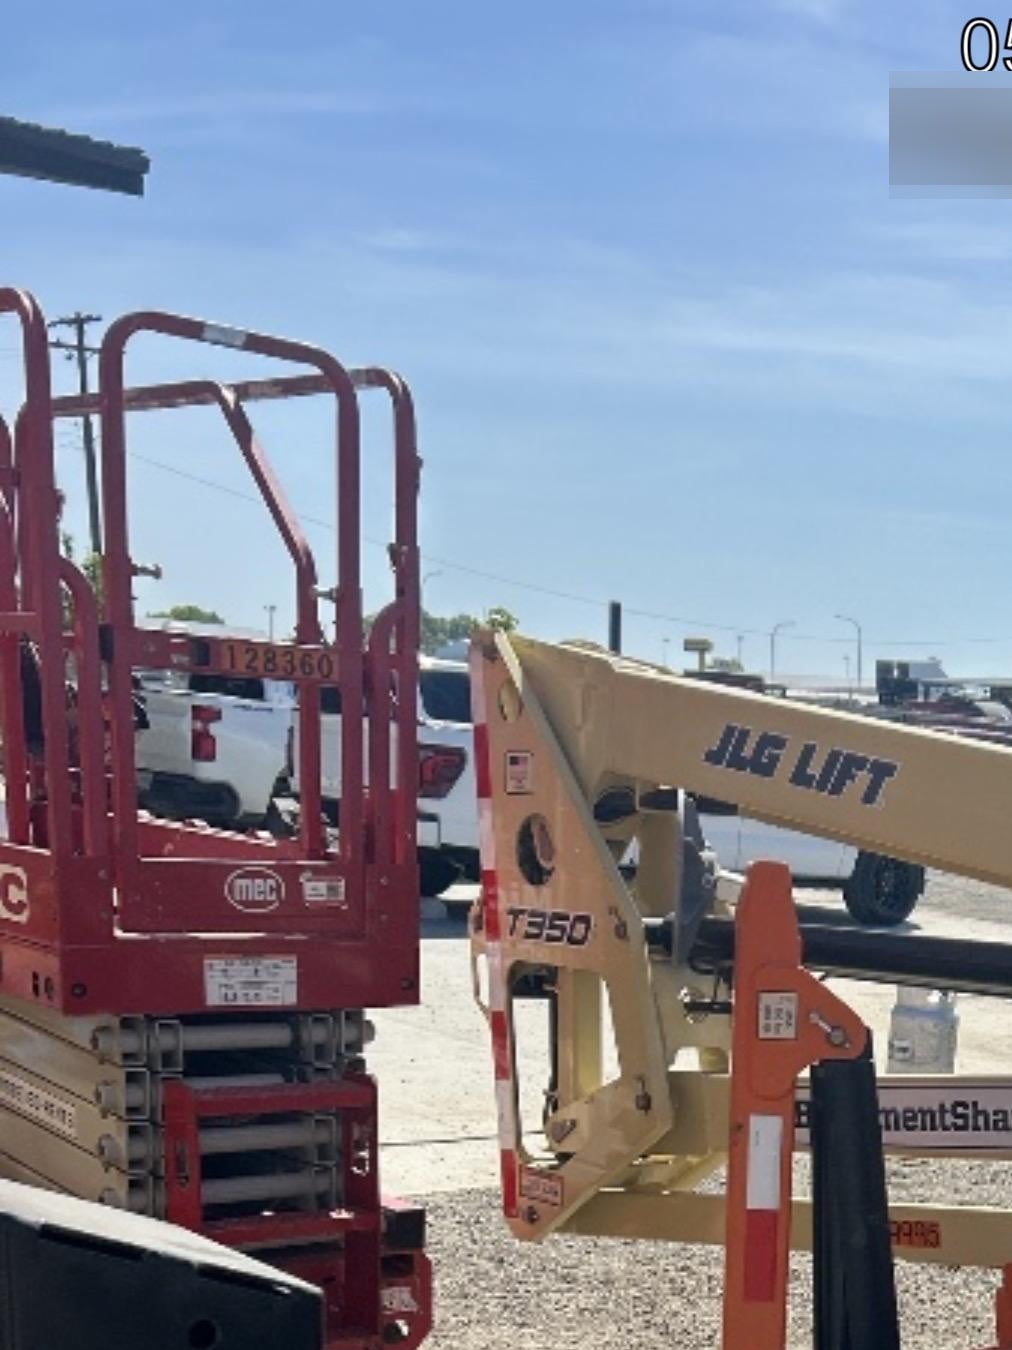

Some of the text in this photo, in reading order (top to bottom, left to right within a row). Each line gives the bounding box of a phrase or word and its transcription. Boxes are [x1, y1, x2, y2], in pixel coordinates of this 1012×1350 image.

[226, 644, 334, 679] 128360
[704, 723, 899, 805] JLG LIFT
[233, 878, 277, 901] mec
[507, 907, 592, 946] T350
